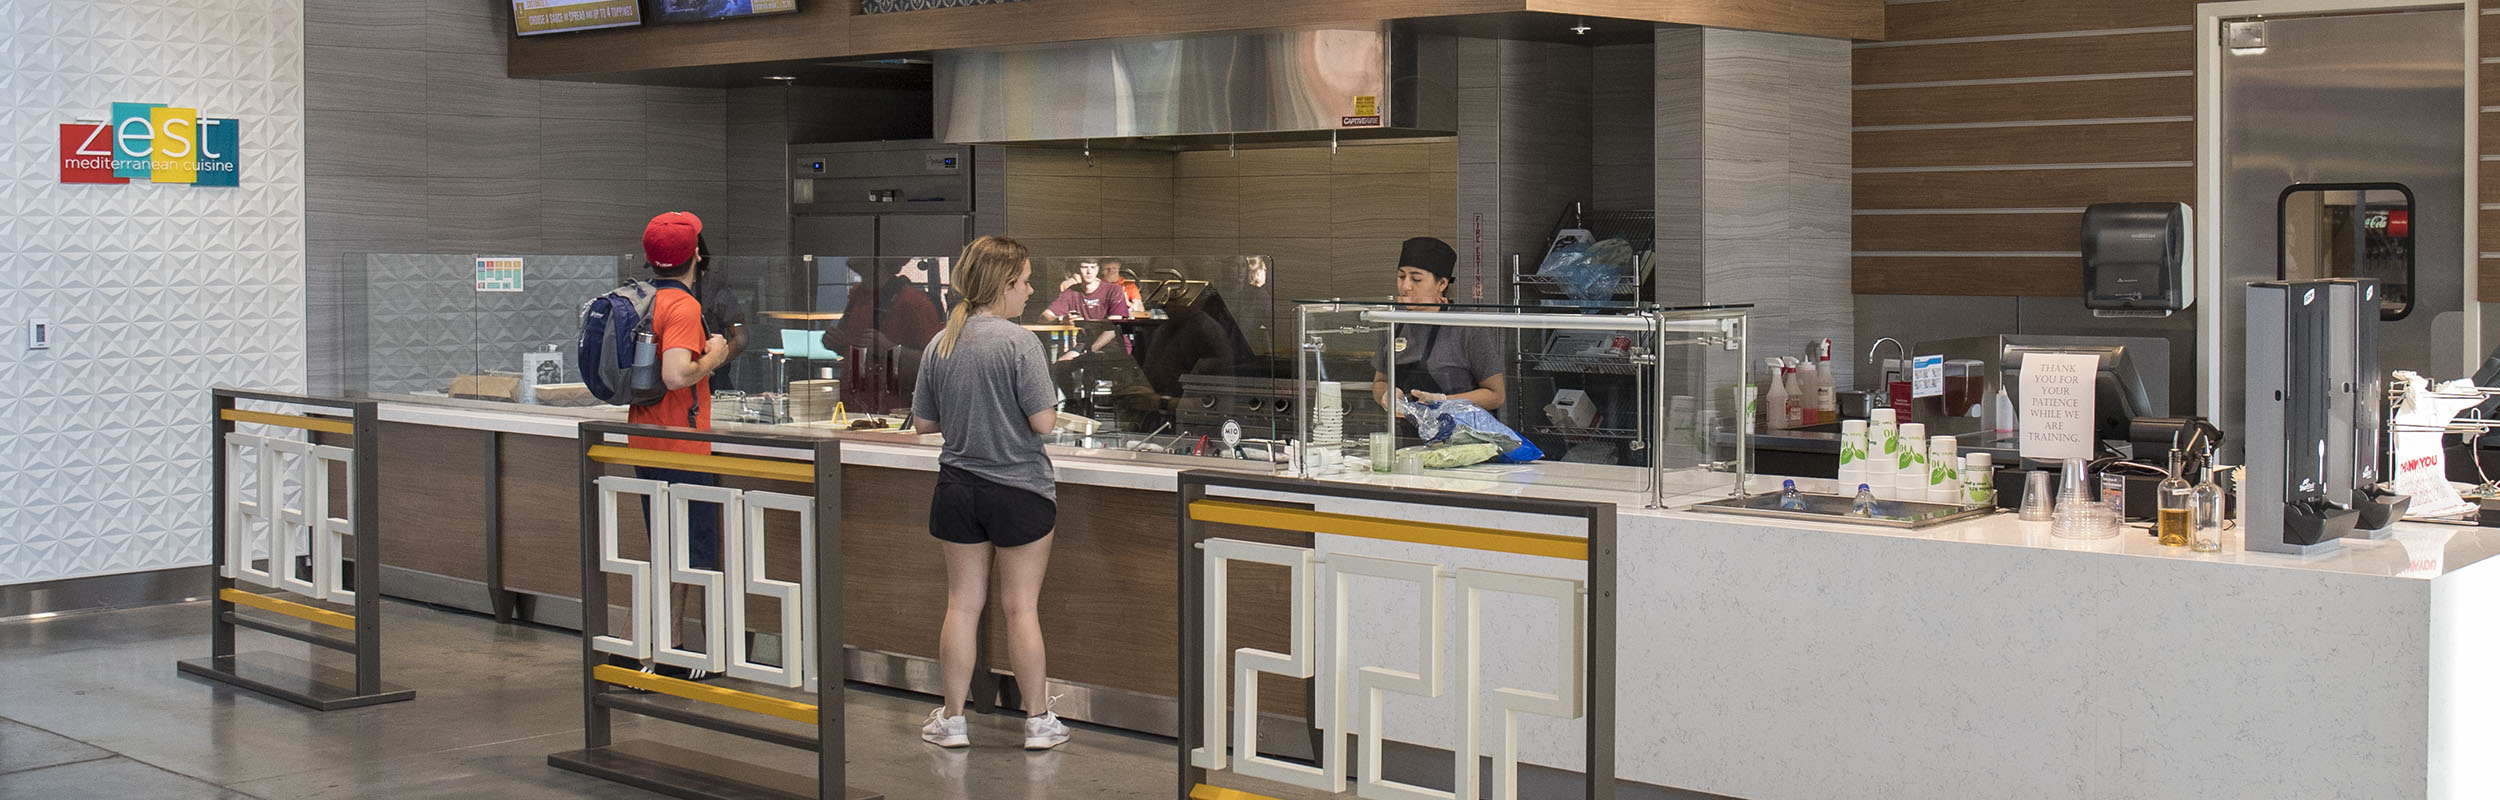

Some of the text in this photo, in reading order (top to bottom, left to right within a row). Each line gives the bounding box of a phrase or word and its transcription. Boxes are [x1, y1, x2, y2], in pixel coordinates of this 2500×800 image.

[75, 108, 220, 159] zest
[65, 157, 234, 172] mediterranean cuisine
[2040, 364, 2077, 373] THANK
[2035, 375, 2079, 384] YOU FOR
[2041, 386, 2070, 396] YOUR
[2032, 397, 2079, 408] PATIENCE
[2030, 409, 2080, 419] WHILE WE
[2045, 421, 2064, 430] ARE
[2028, 432, 2081, 443] TRAINING.
[2419, 455, 2438, 468] YOU
